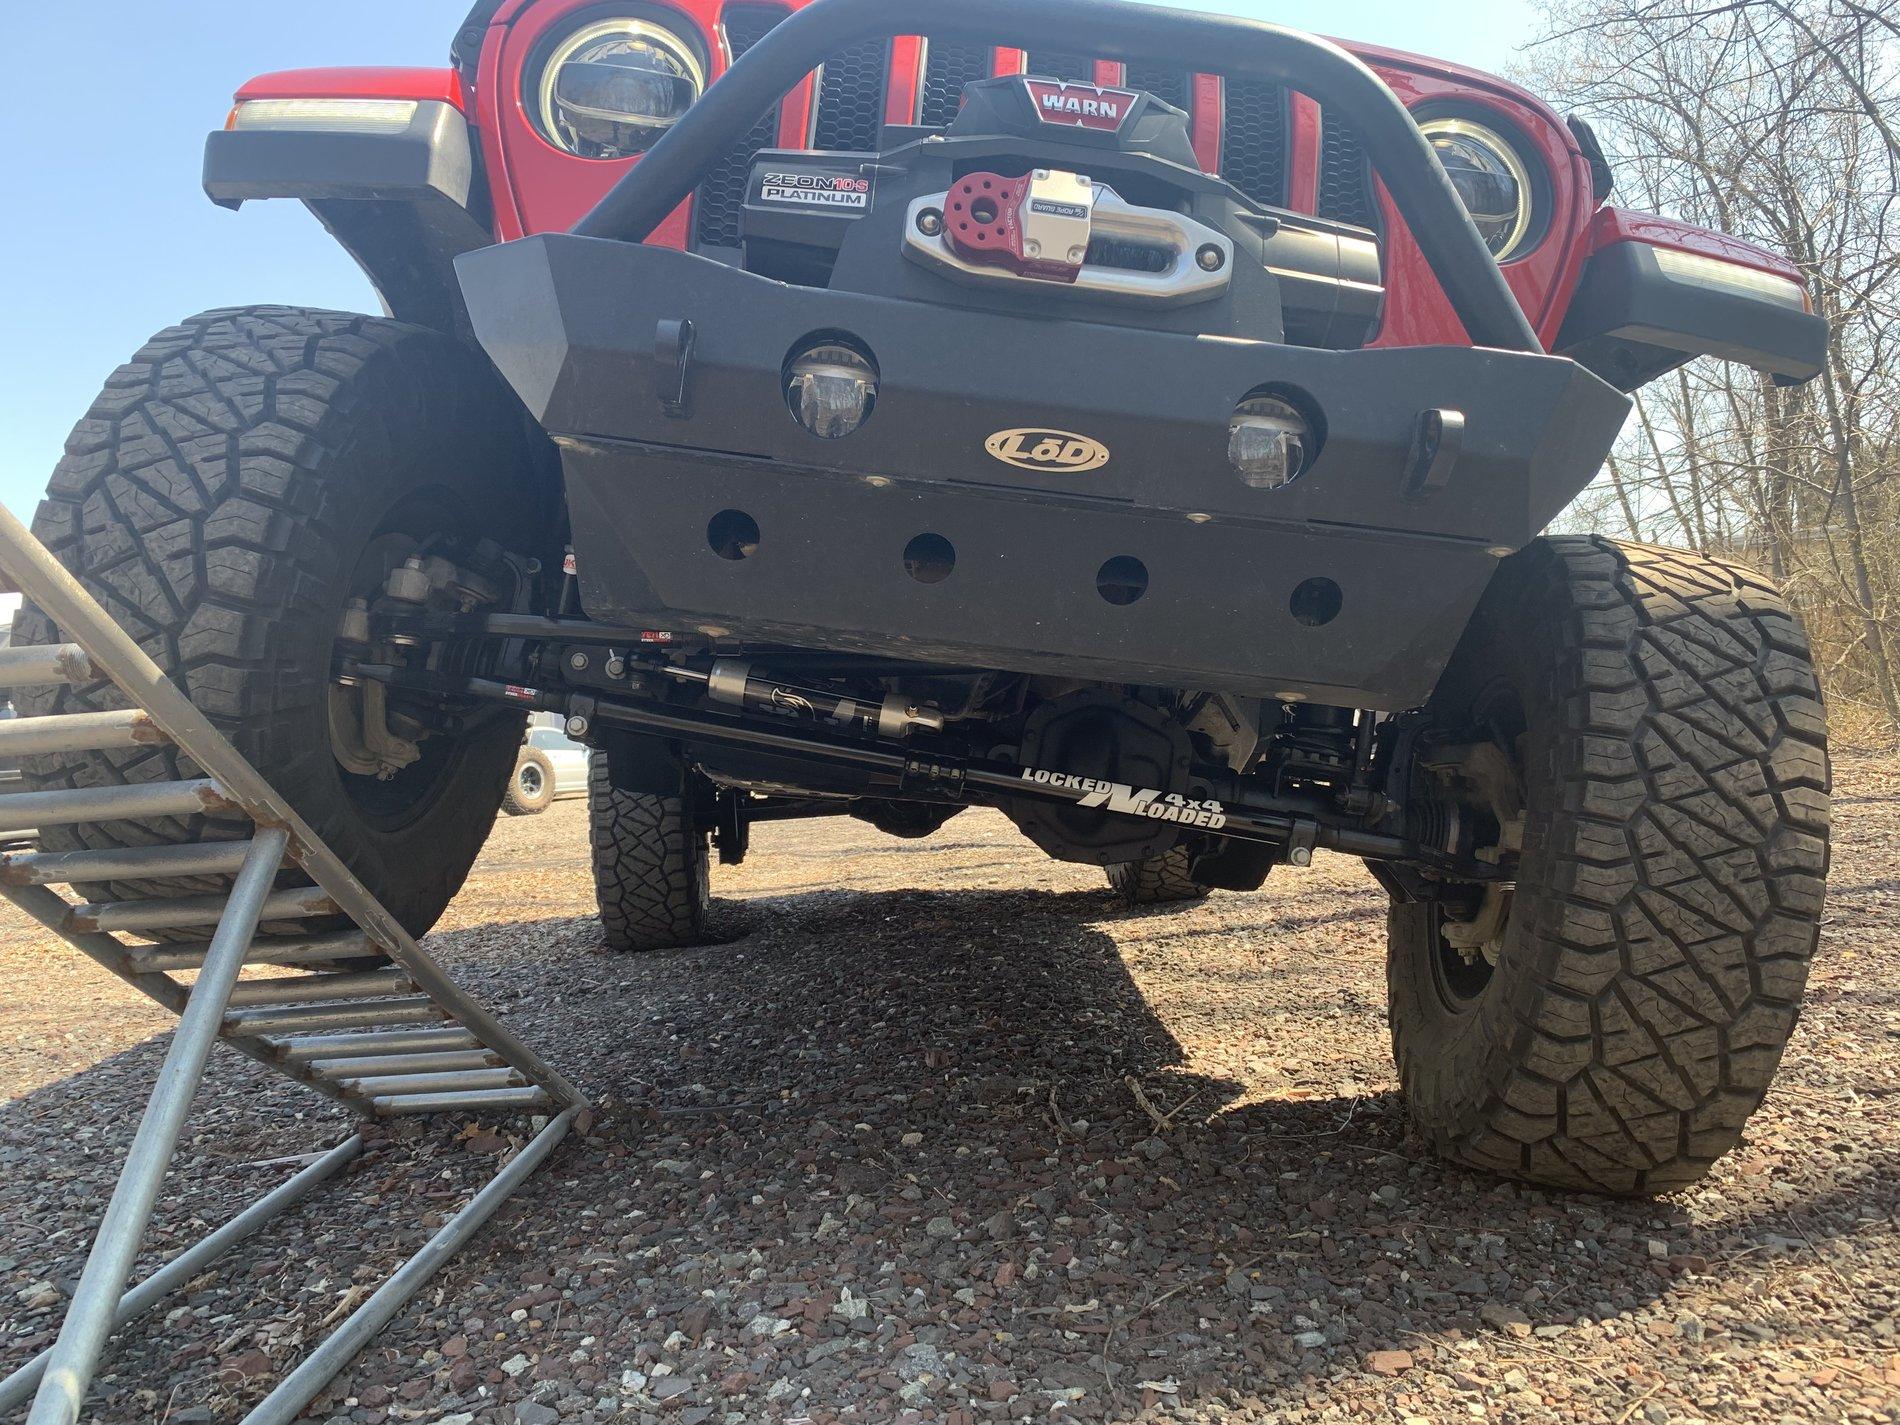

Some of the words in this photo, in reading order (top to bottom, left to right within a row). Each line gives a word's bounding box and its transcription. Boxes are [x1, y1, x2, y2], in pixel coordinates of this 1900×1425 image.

[1042, 94, 1117, 118] WARN
[767, 188, 861, 204] PLATINUM
[1033, 203, 1055, 213] GUARD
[1021, 767, 1113, 795] LOCKED
[1133, 800, 1226, 829] LOADED
[1164, 792, 1224, 814] 4x4
